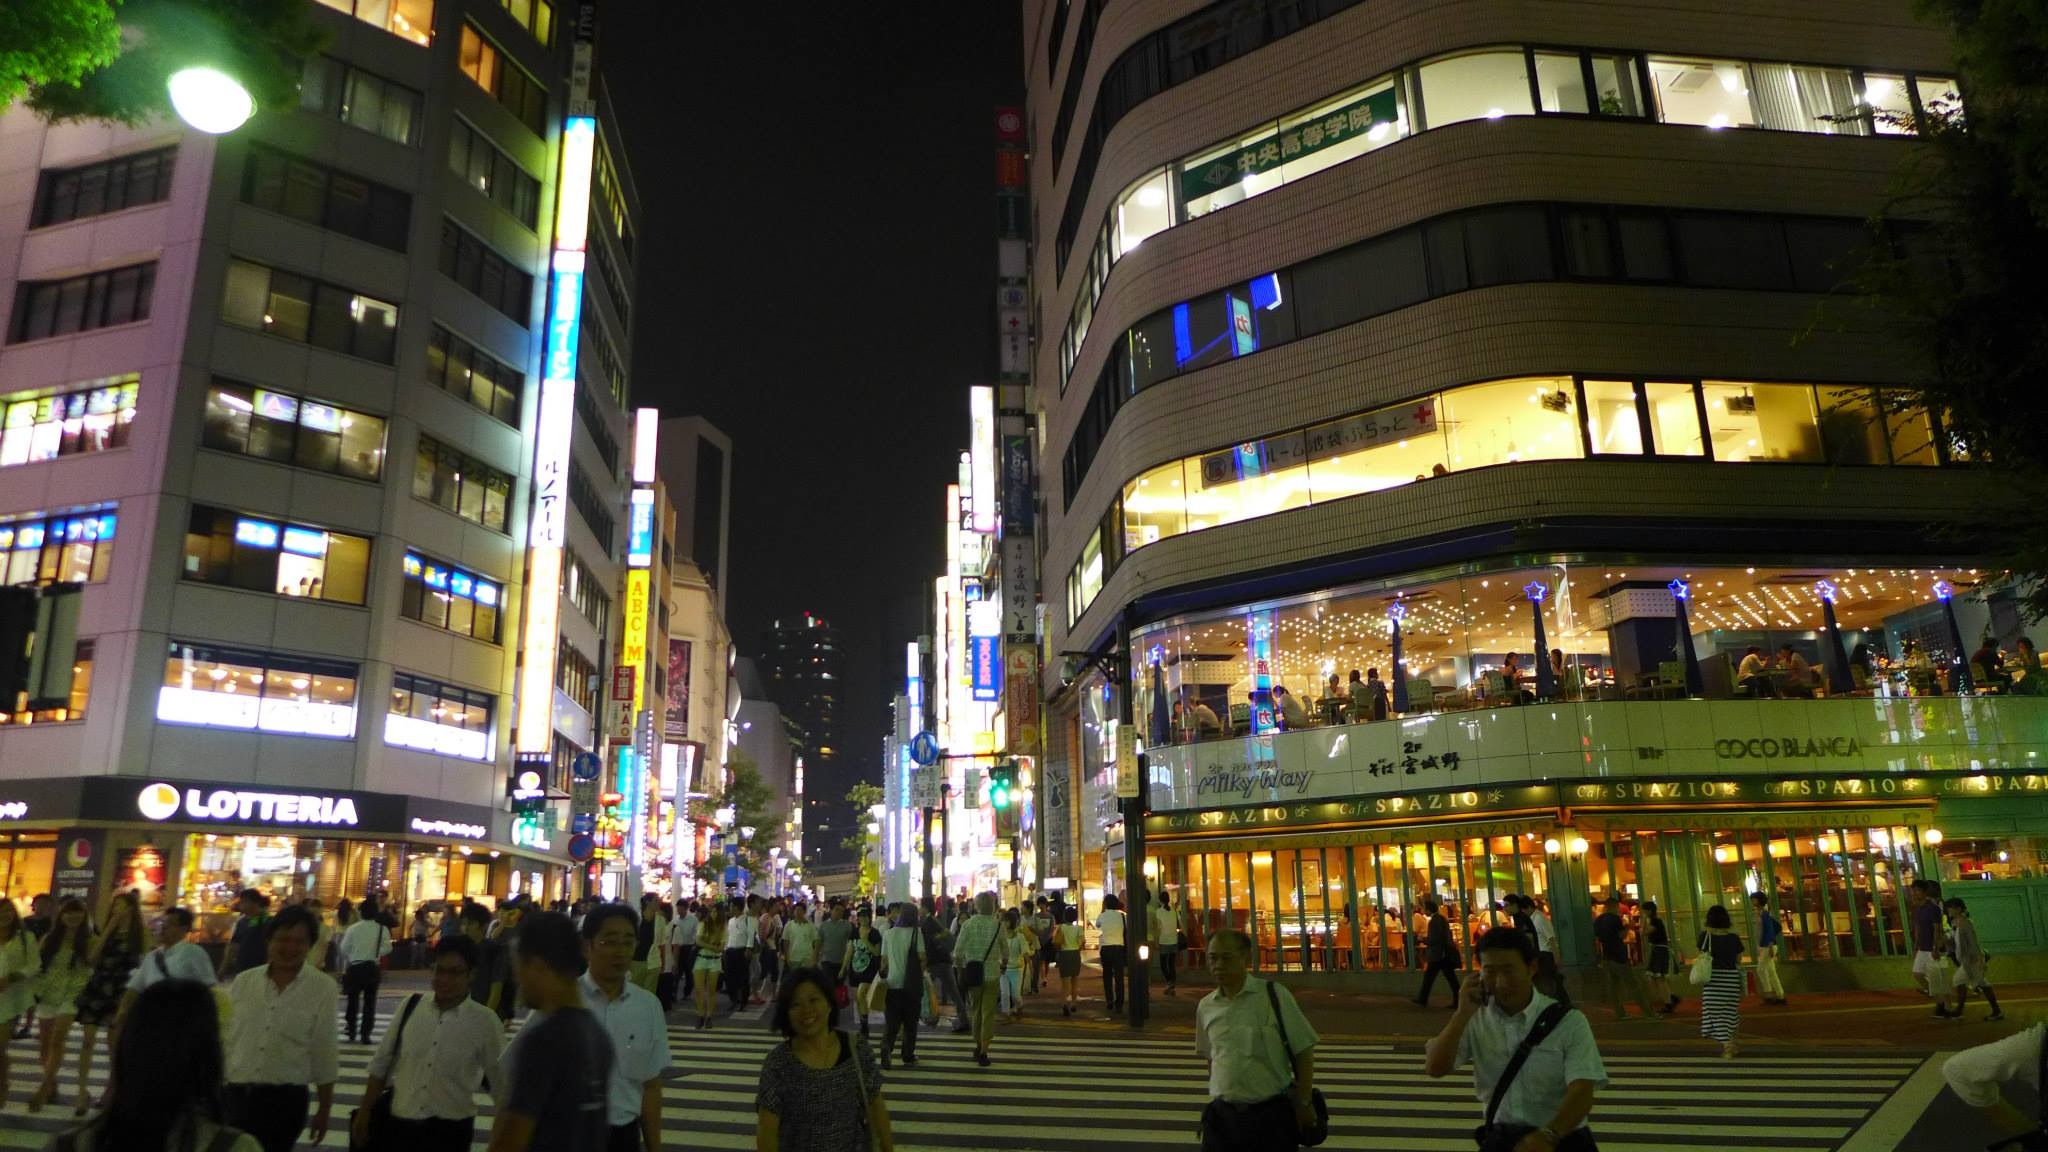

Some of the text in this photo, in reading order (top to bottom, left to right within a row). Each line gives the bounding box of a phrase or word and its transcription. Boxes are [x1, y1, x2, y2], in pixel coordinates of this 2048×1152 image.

[1236, 104, 1373, 174] 中央高等学院
[538, 460, 560, 541] ルノアール
[978, 638, 992, 686] PROMISE
[1403, 741, 1423, 754] 2F
[1715, 737, 1861, 759] COCO BLANCA
[1368, 751, 1461, 777] そば 宮城野
[1197, 769, 1314, 799] Milky Way
[1615, 781, 1716, 799] SPAZIO
[1800, 778, 1896, 795] SPAZIO
[186, 788, 358, 825] LOTTERIA
[1375, 791, 1478, 813] SPAZIO
[1199, 806, 1288, 826] SPAZIO
[1809, 814, 1872, 826] SPAZIO
[1312, 832, 1374, 847] SPAZIO
[1454, 823, 1523, 837] SPAZIO
